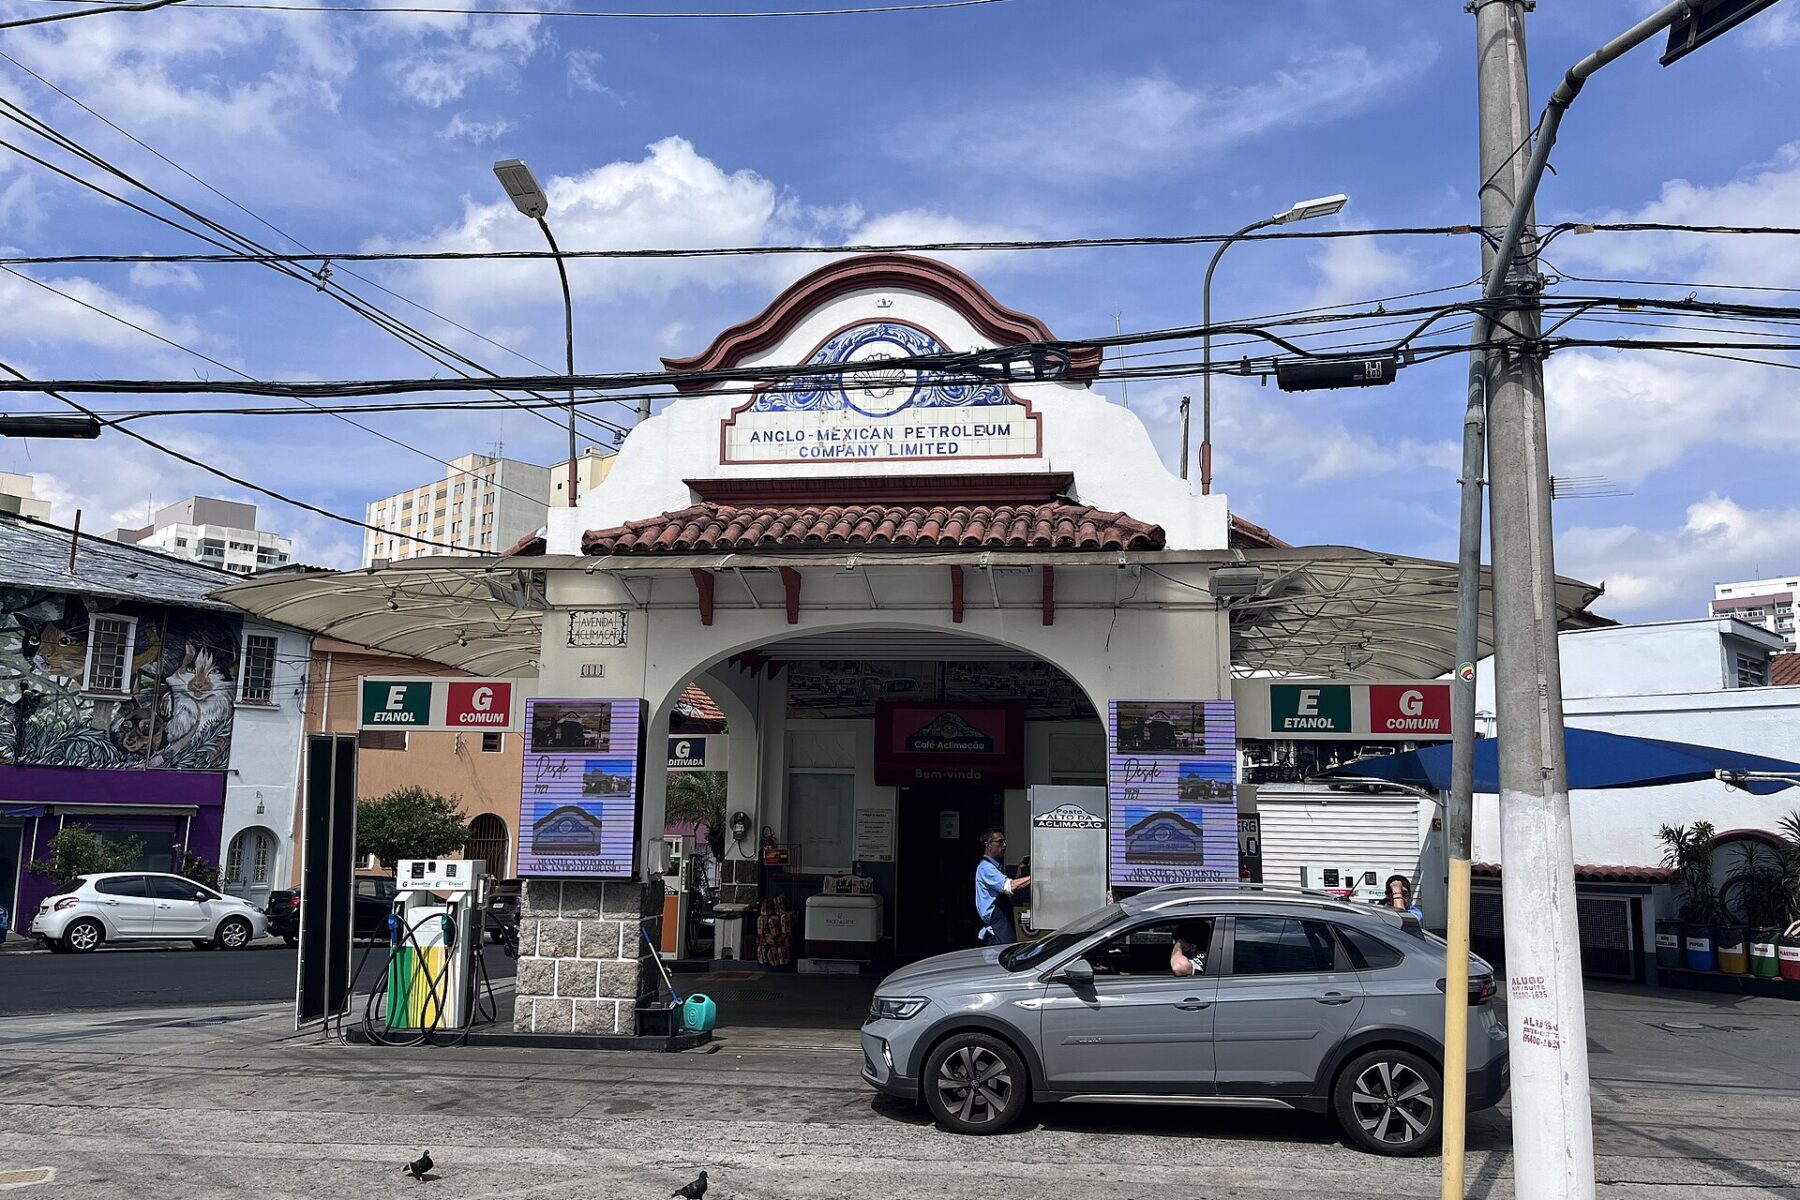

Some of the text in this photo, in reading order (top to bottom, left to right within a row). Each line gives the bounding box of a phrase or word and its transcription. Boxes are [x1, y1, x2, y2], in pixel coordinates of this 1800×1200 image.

[750, 424, 1011, 443] ANGLO-MEXICAN PETROLEUM
[799, 442, 959, 458] COMPANY LIMITED
[581, 617, 614, 627] AVENIDA
[386, 685, 407, 710] E
[471, 686, 494, 711] G
[1297, 689, 1321, 716] E
[1399, 690, 1424, 716] G
[373, 711, 416, 722] ETANOL
[459, 712, 504, 723] COMUM
[1284, 718, 1335, 729] ETANOL
[1386, 718, 1439, 730] COMUM
[675, 741, 690, 758] G
[914, 740, 985, 751] Café Aclimação
[535, 755, 569, 782] Desde
[915, 767, 982, 780] Bem-vindo
[1123, 757, 1161, 786] Desde
[1037, 820, 1102, 829] ACLIMAÇÃO
